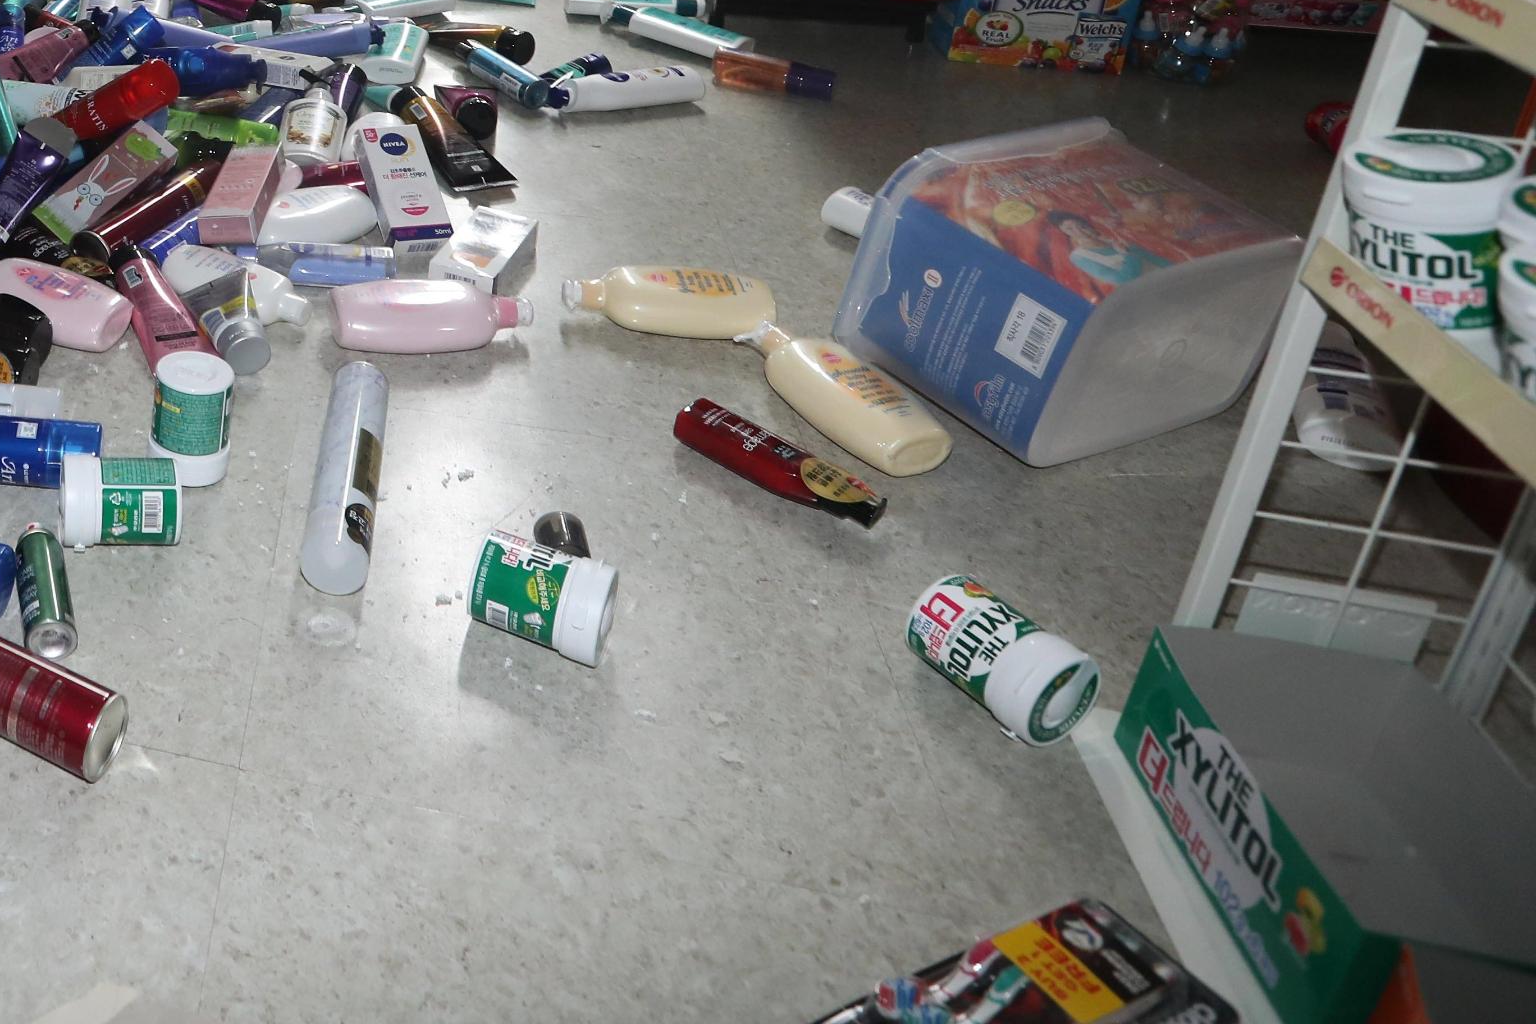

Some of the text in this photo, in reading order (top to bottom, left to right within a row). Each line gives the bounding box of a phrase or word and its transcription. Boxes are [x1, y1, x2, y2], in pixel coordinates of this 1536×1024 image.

[0, 35, 18, 44] Art
[1079, 23, 1124, 36] Welch's
[434, 228, 452, 236] 50ml
[1369, 223, 1415, 248] THE
[1346, 282, 1394, 327] ORION
[920, 591, 965, 632] 더
[947, 604, 1018, 678] XYLITOL
[979, 635, 1009, 666] THE
[1138, 729, 1168, 795] 더
[1218, 744, 1255, 804] THE
[1171, 716, 1278, 905] XYLITOL
